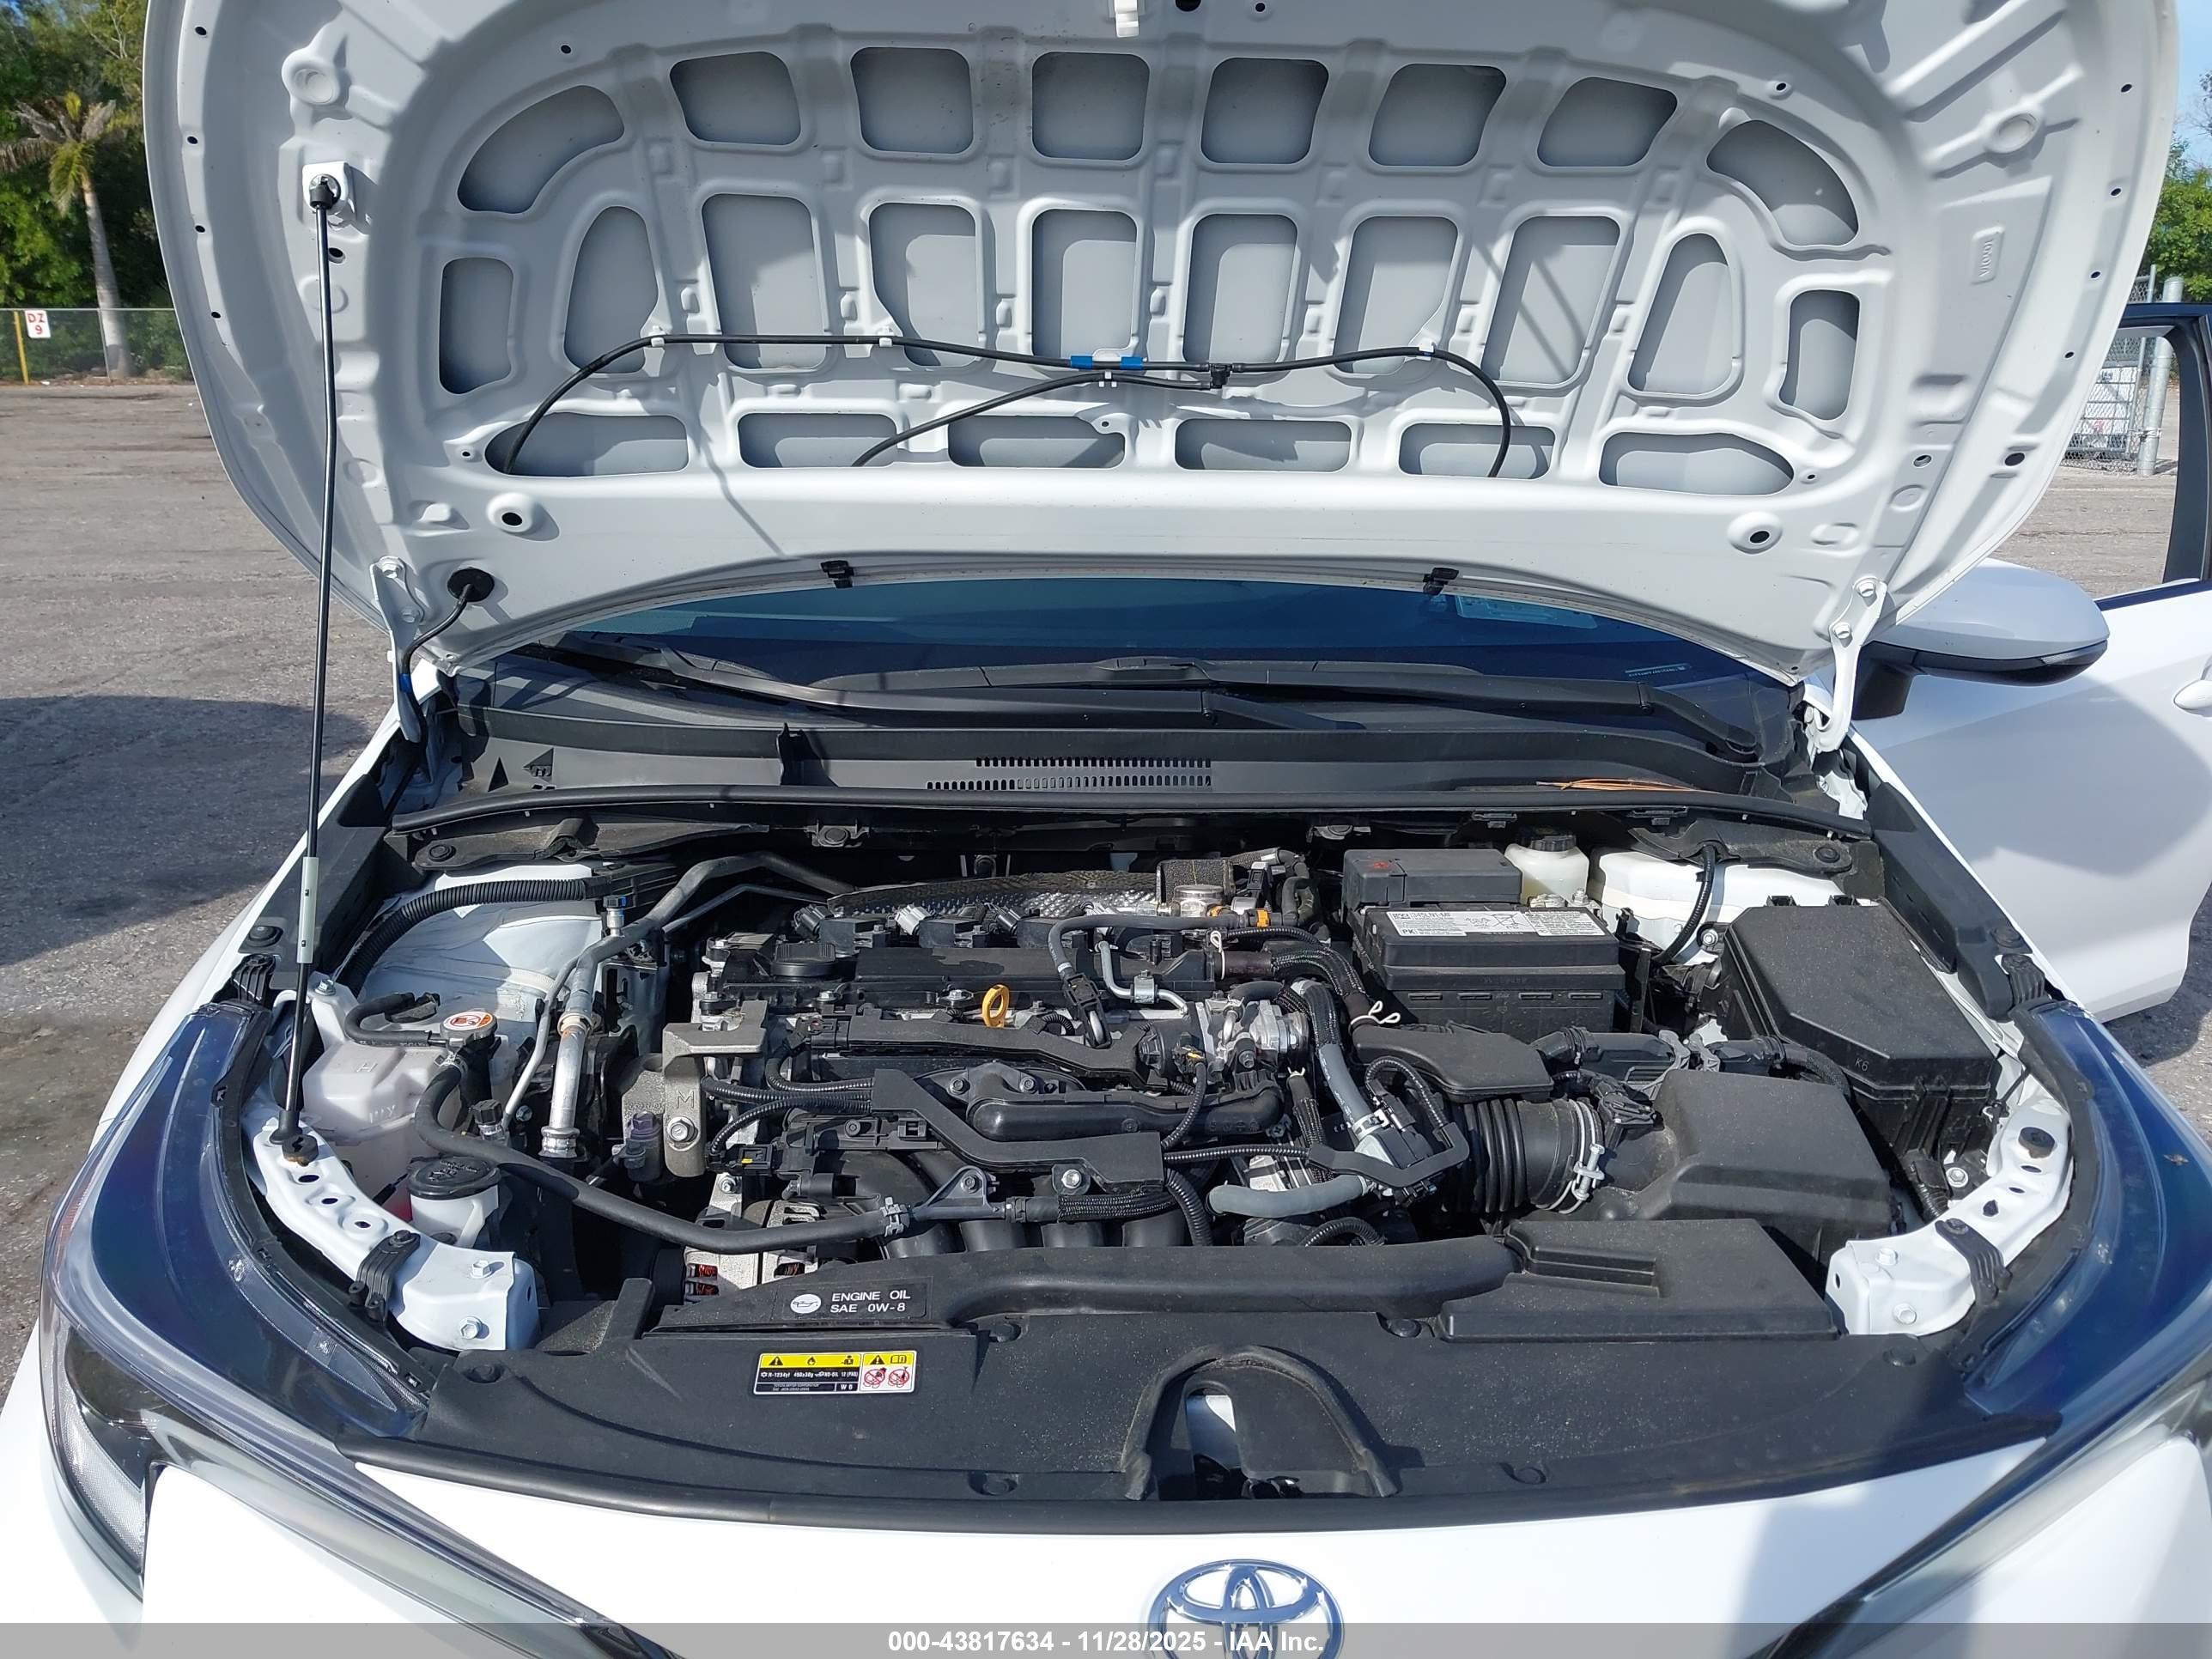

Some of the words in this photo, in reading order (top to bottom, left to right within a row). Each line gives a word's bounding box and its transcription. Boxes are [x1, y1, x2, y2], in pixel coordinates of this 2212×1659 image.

[35, 325, 43, 335] 9
[1855, 1057, 1869, 1072] K6
[676, 1089, 695, 1109] M
[831, 1291, 881, 1302] ENGINE
[889, 1289, 911, 1300] OIL
[830, 1304, 859, 1313] SAE
[867, 1302, 906, 1313] 0W-8
